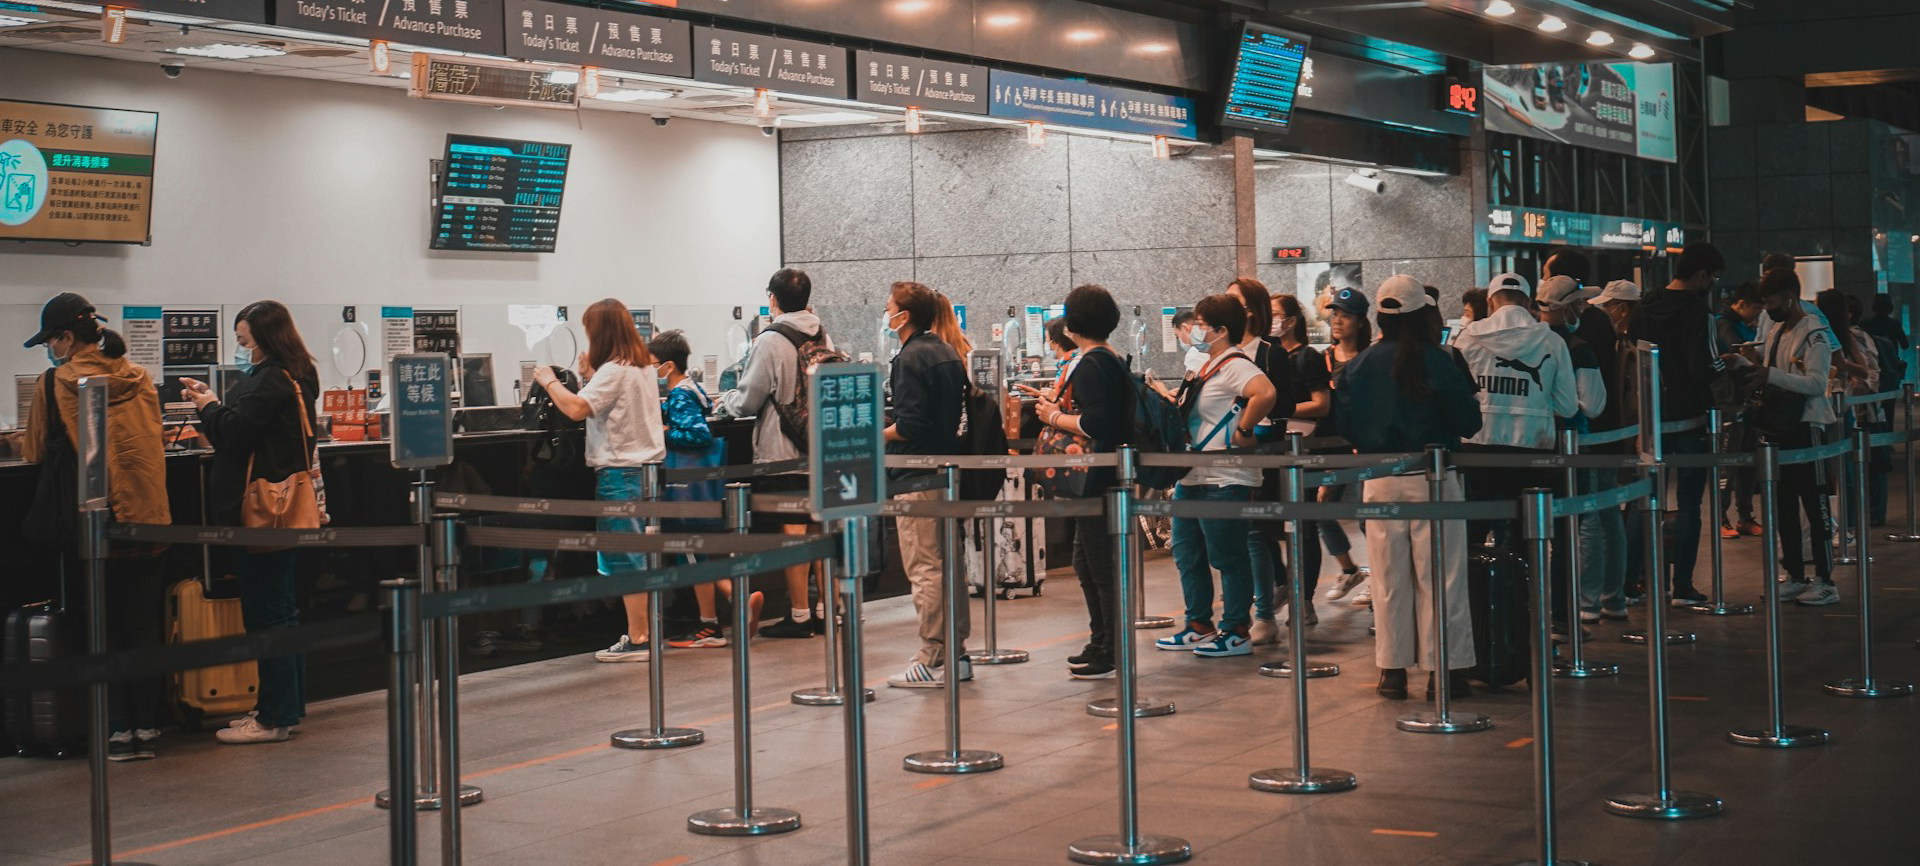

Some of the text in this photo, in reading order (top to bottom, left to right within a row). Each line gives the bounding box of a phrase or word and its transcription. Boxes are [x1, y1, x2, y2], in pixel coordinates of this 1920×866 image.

[298, 1, 367, 25] Today's Ticket
[522, 10, 578, 34] 當日票
[106, 9, 126, 43] 7
[394, 16, 482, 39] Advance Purchase
[608, 22, 662, 45] 預售票
[522, 33, 580, 53] Today's Ticket
[602, 44, 674, 63] Advance Purchase
[711, 38, 759, 60] 當日票
[710, 59, 761, 77] Today's Ticket
[783, 49, 827, 70] 預售票
[778, 68, 835, 87] Advance Purchase
[869, 61, 909, 80] 當日票
[869, 80, 911, 96] Today's Ticket
[925, 87, 976, 103] Advance Purchase
[0, 118, 39, 136] 車安全
[45, 122, 94, 140] 為您守護
[1278, 249, 1302, 258] 18:42
[400, 363, 442, 383] 請在此
[406, 383, 436, 403] 等候
[821, 374, 872, 402] 定期票
[1477, 375, 1530, 397] PUMA
[822, 403, 873, 430] 回數票
